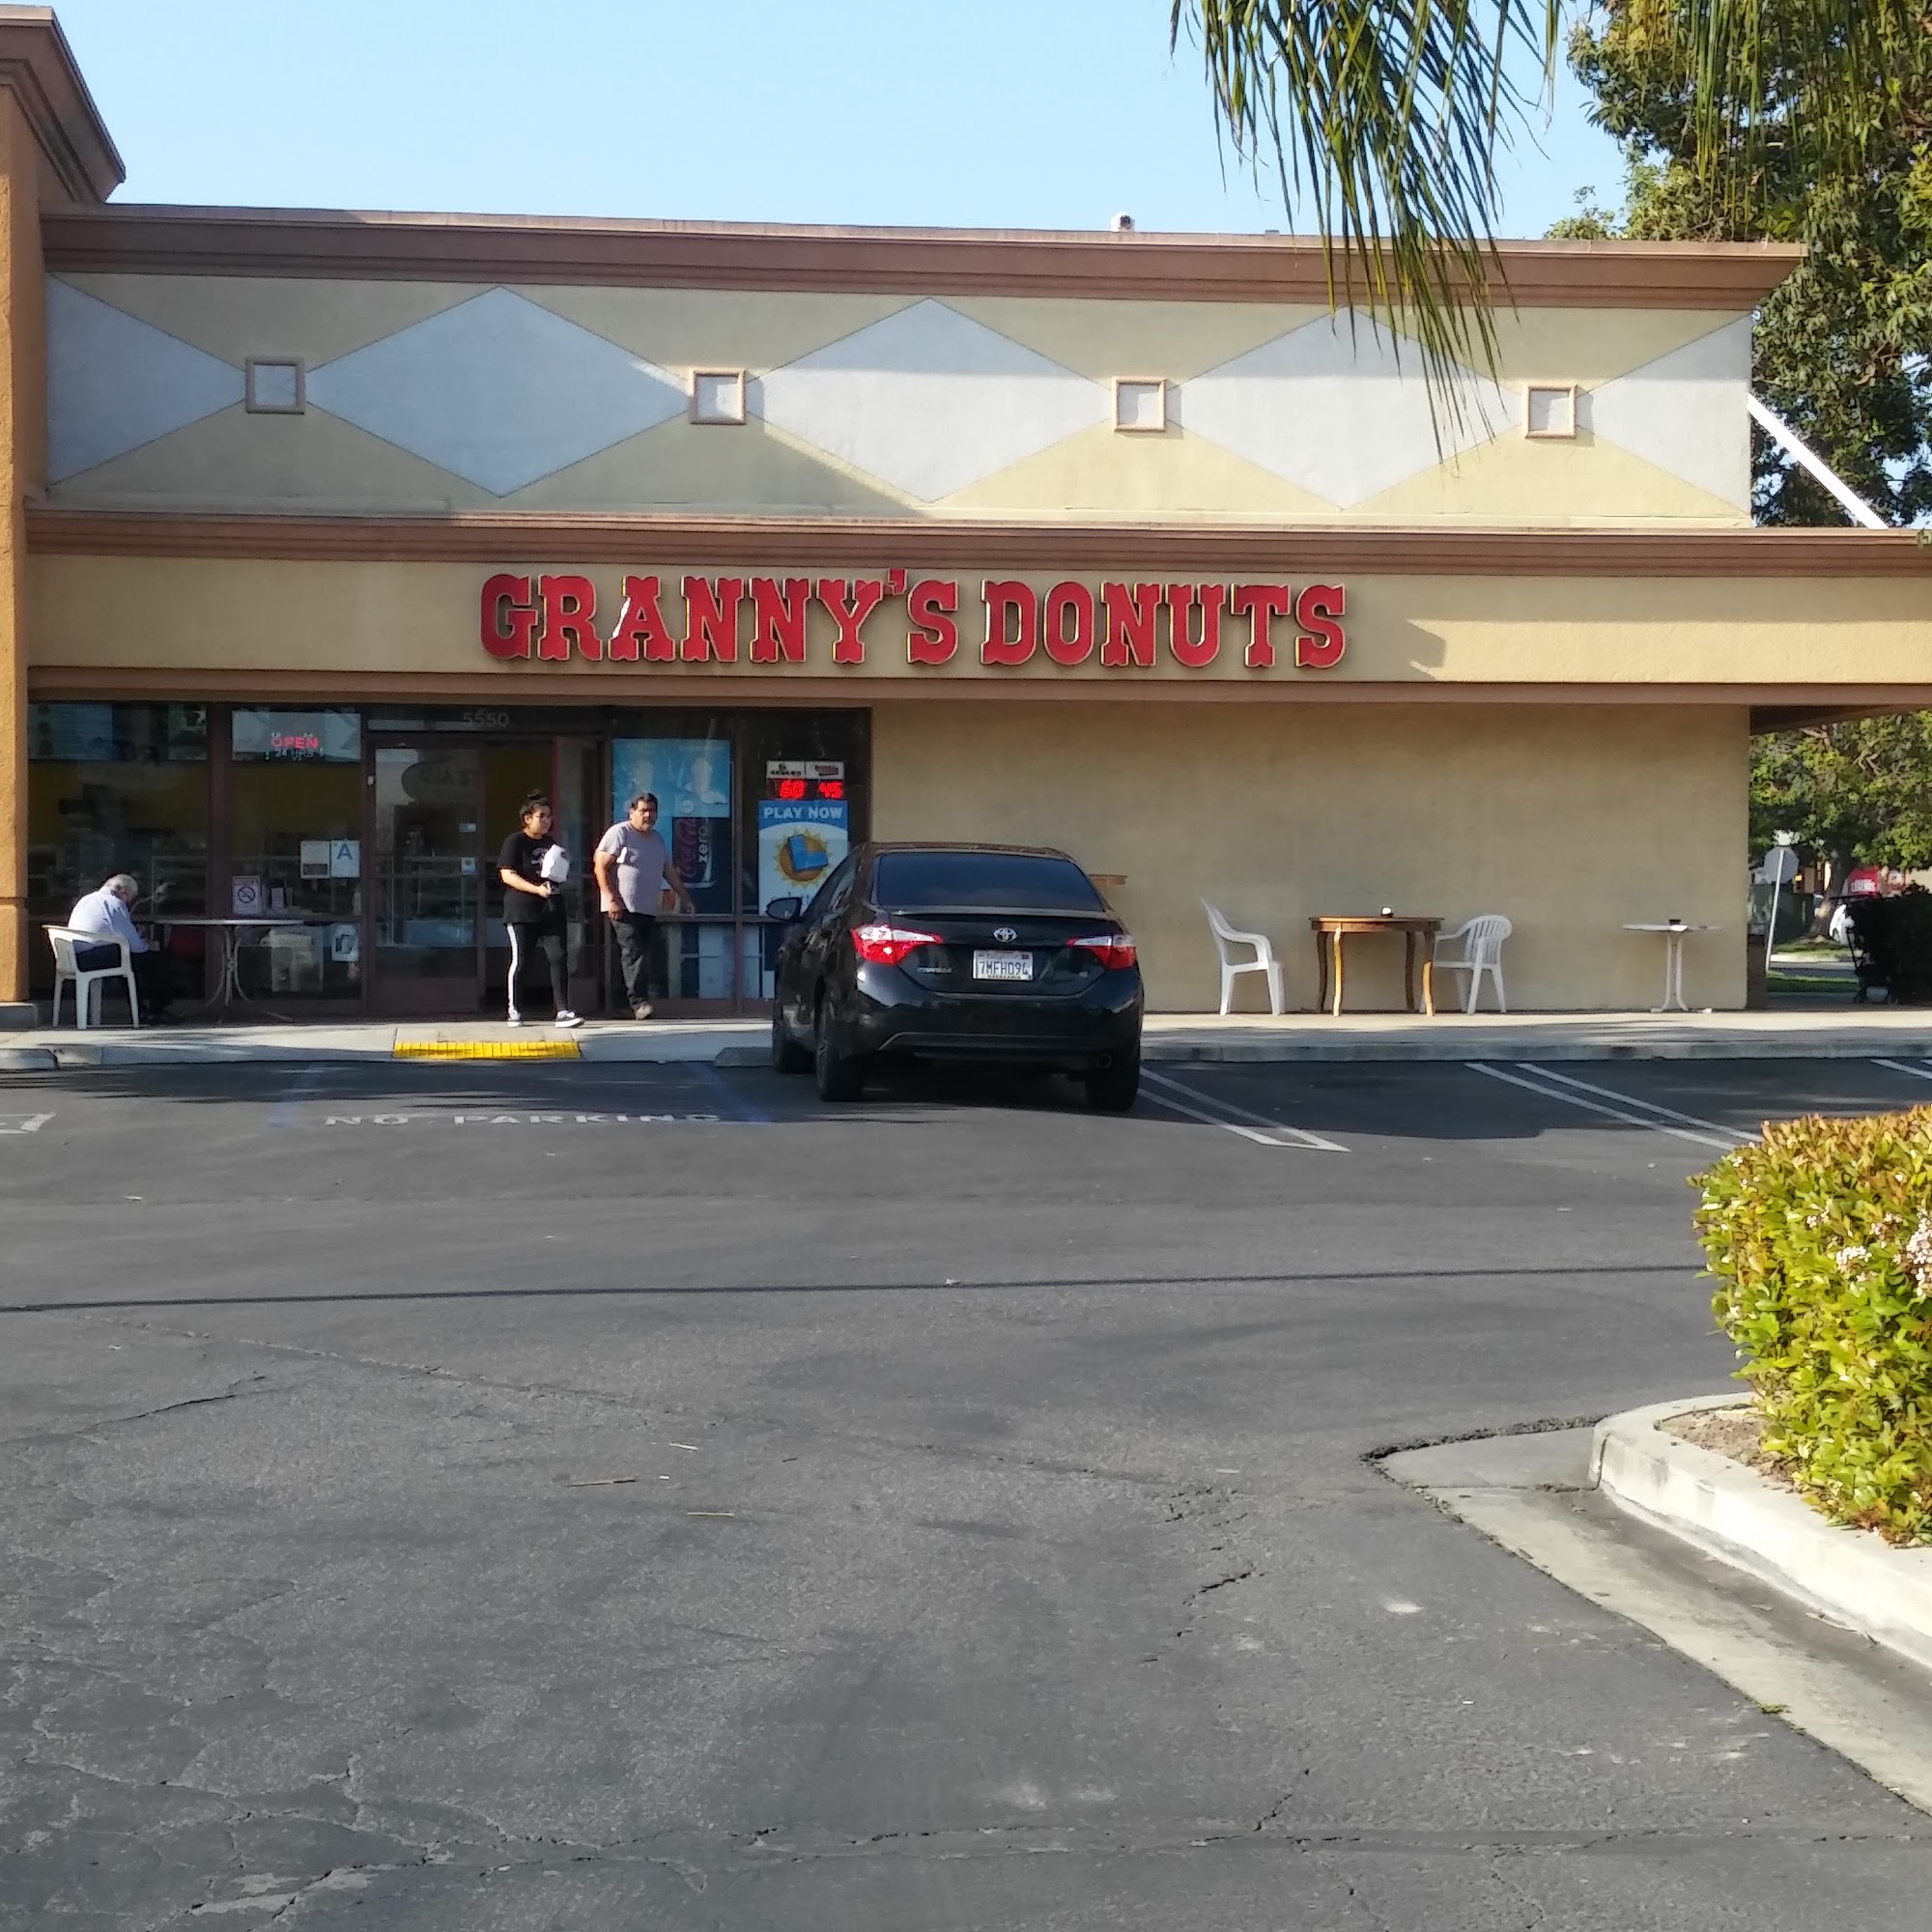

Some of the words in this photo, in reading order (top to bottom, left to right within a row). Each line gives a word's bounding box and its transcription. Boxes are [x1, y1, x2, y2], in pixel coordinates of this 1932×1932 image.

[480, 568, 958, 665] GRANNY'S
[980, 579, 1346, 668] DONUTS
[464, 712, 510, 727] 5550
[271, 736, 319, 750] OPEN
[763, 807, 803, 819] PLAY
[809, 807, 843, 819] NOW
[336, 843, 353, 860] A
[697, 826, 708, 864] zero
[325, 1115, 409, 1125] NO
[453, 1114, 720, 1124] PARKING
